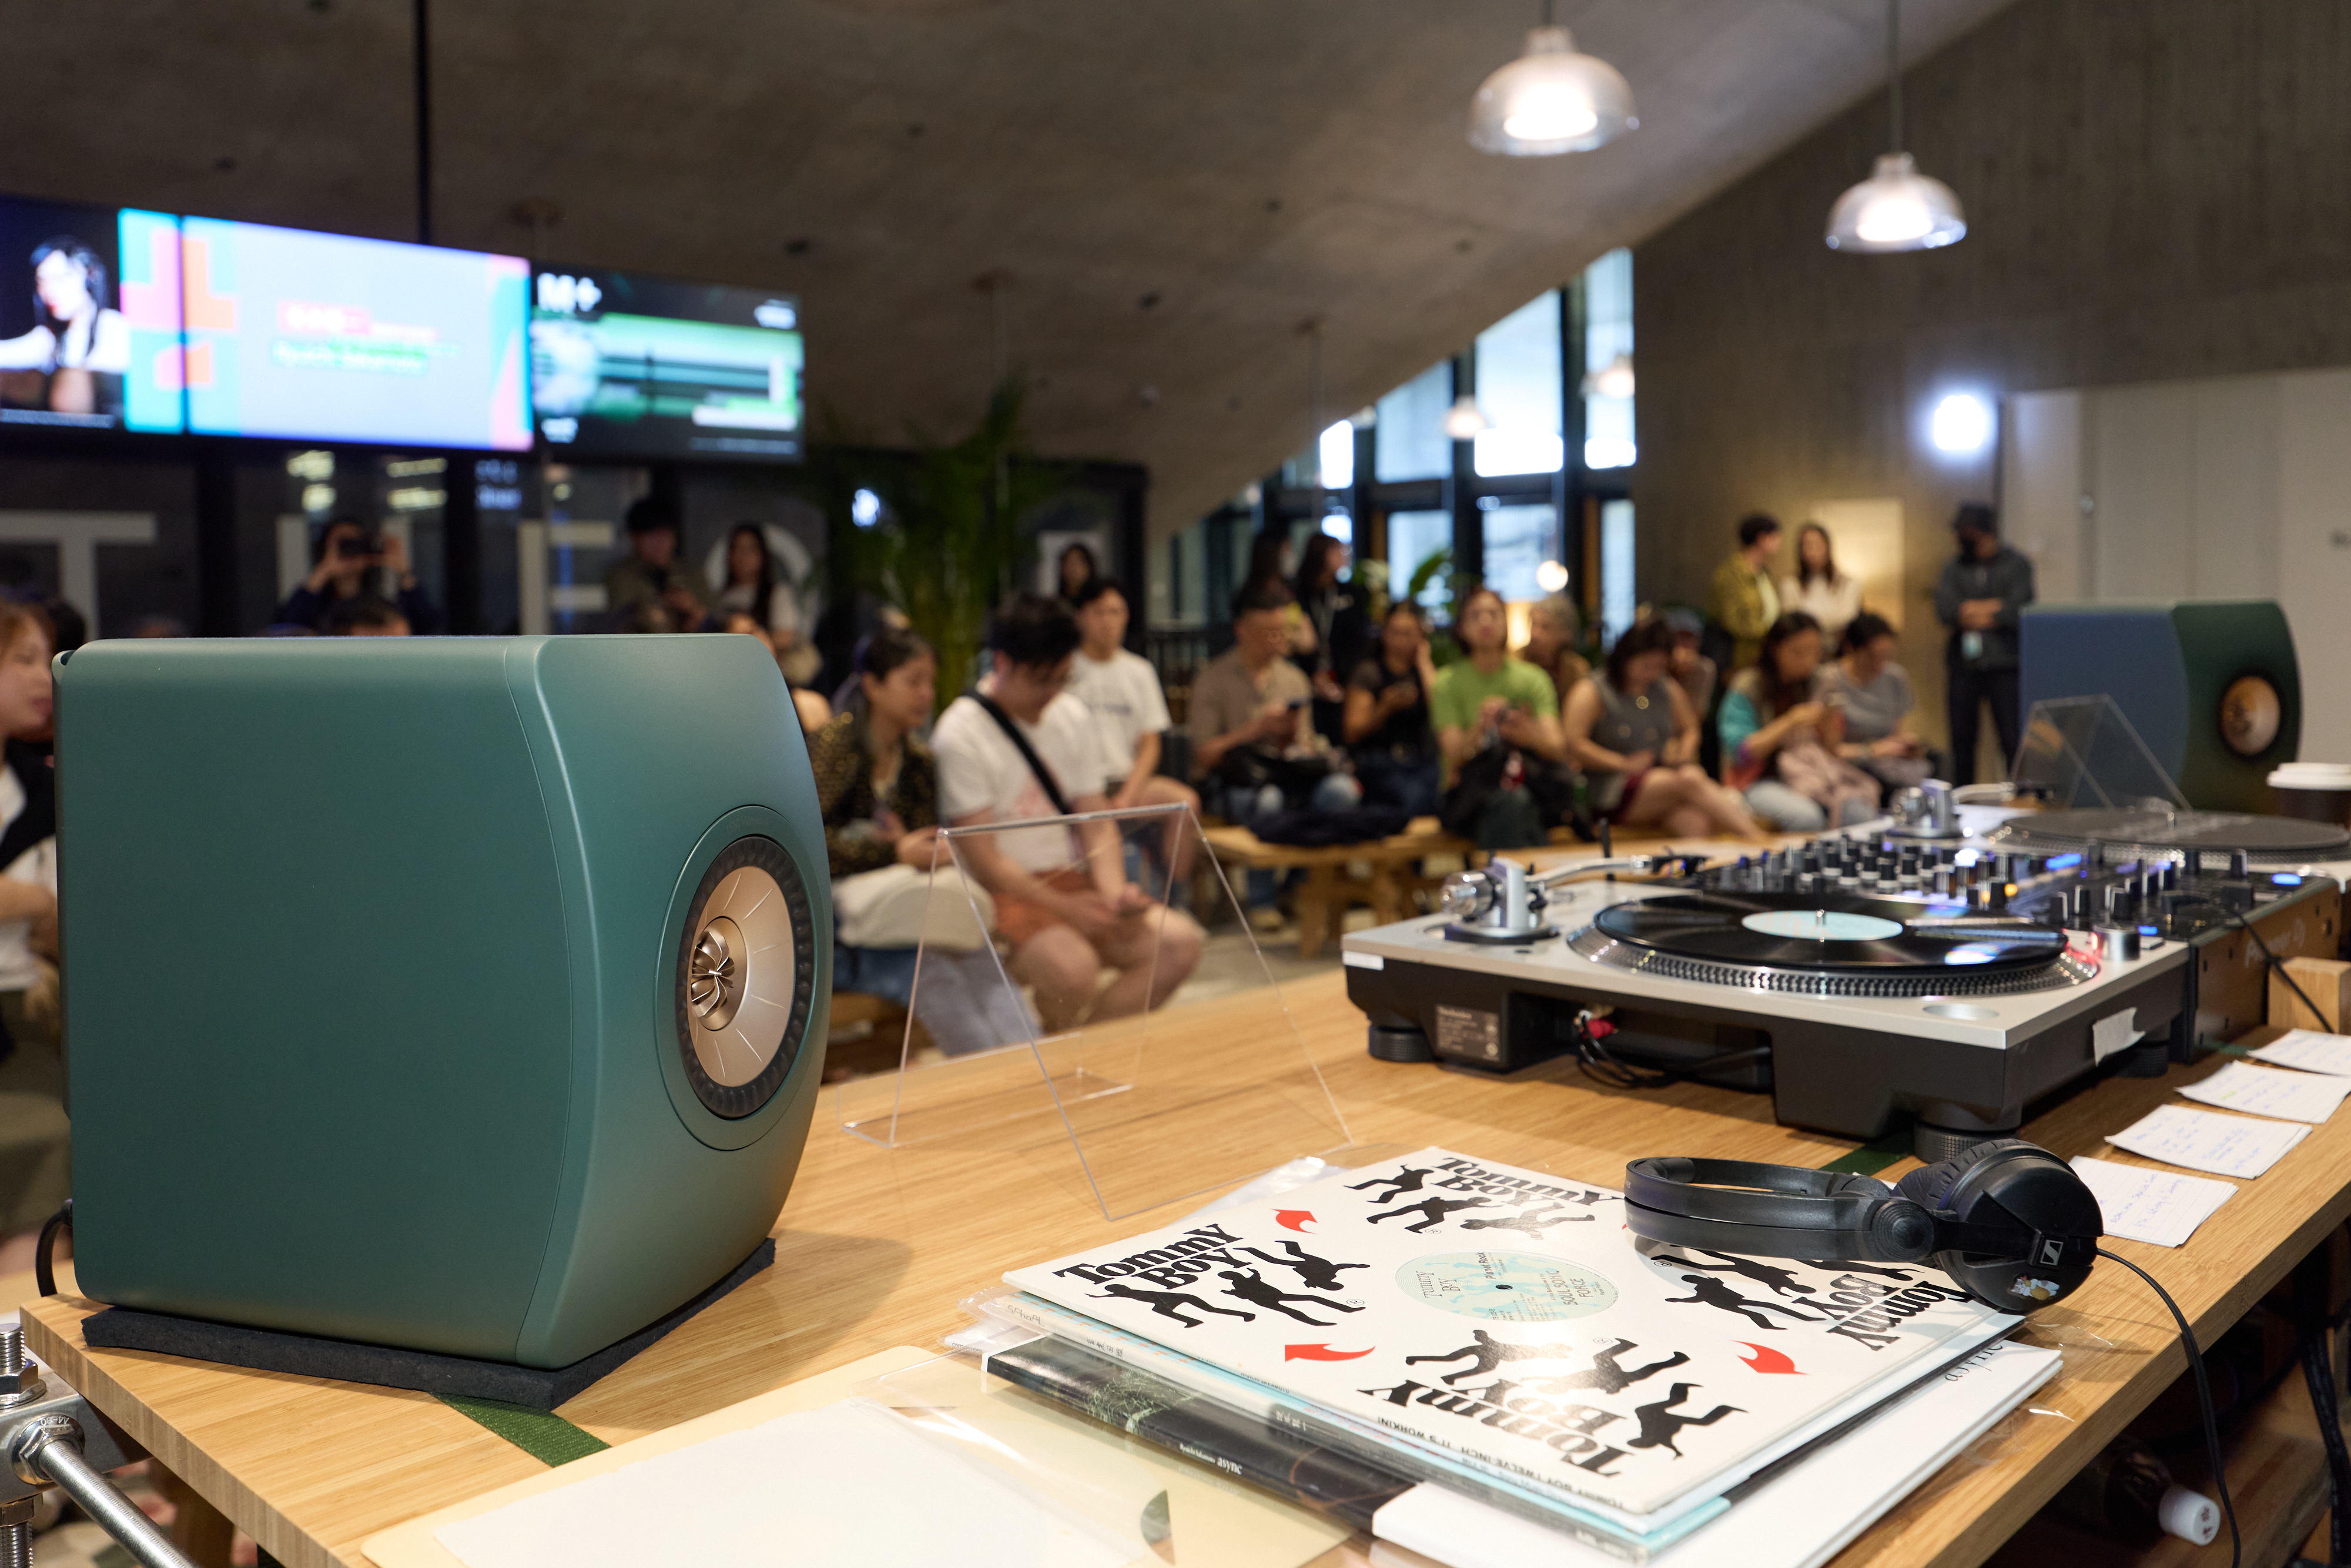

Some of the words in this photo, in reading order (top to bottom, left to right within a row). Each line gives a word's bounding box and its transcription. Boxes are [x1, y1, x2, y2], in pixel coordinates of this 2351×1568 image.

[1431, 1157, 1626, 1207] Tommy
[1431, 1177, 1546, 1207] Boy
[1051, 1223, 1245, 1285] Tommy
[1475, 1251, 1489, 1264] Rock
[1131, 1248, 1252, 1290] Boy
[1484, 1262, 1496, 1279] Planet
[1546, 1270, 1569, 1288] SONIC
[1416, 1271, 1442, 1298] Tommy
[1438, 1278, 1461, 1292] Boy
[1558, 1289, 1578, 1305] SOUL
[1570, 1278, 1593, 1298] FORCE
[1791, 1275, 1901, 1320] Boy
[1826, 1281, 1977, 1351] Tommy
[40, 1415, 70, 1426] A4-80
[1452, 1379, 1628, 1438] Boy
[1357, 1380, 1637, 1477] Tommy
[1216, 1456, 1243, 1476] async
